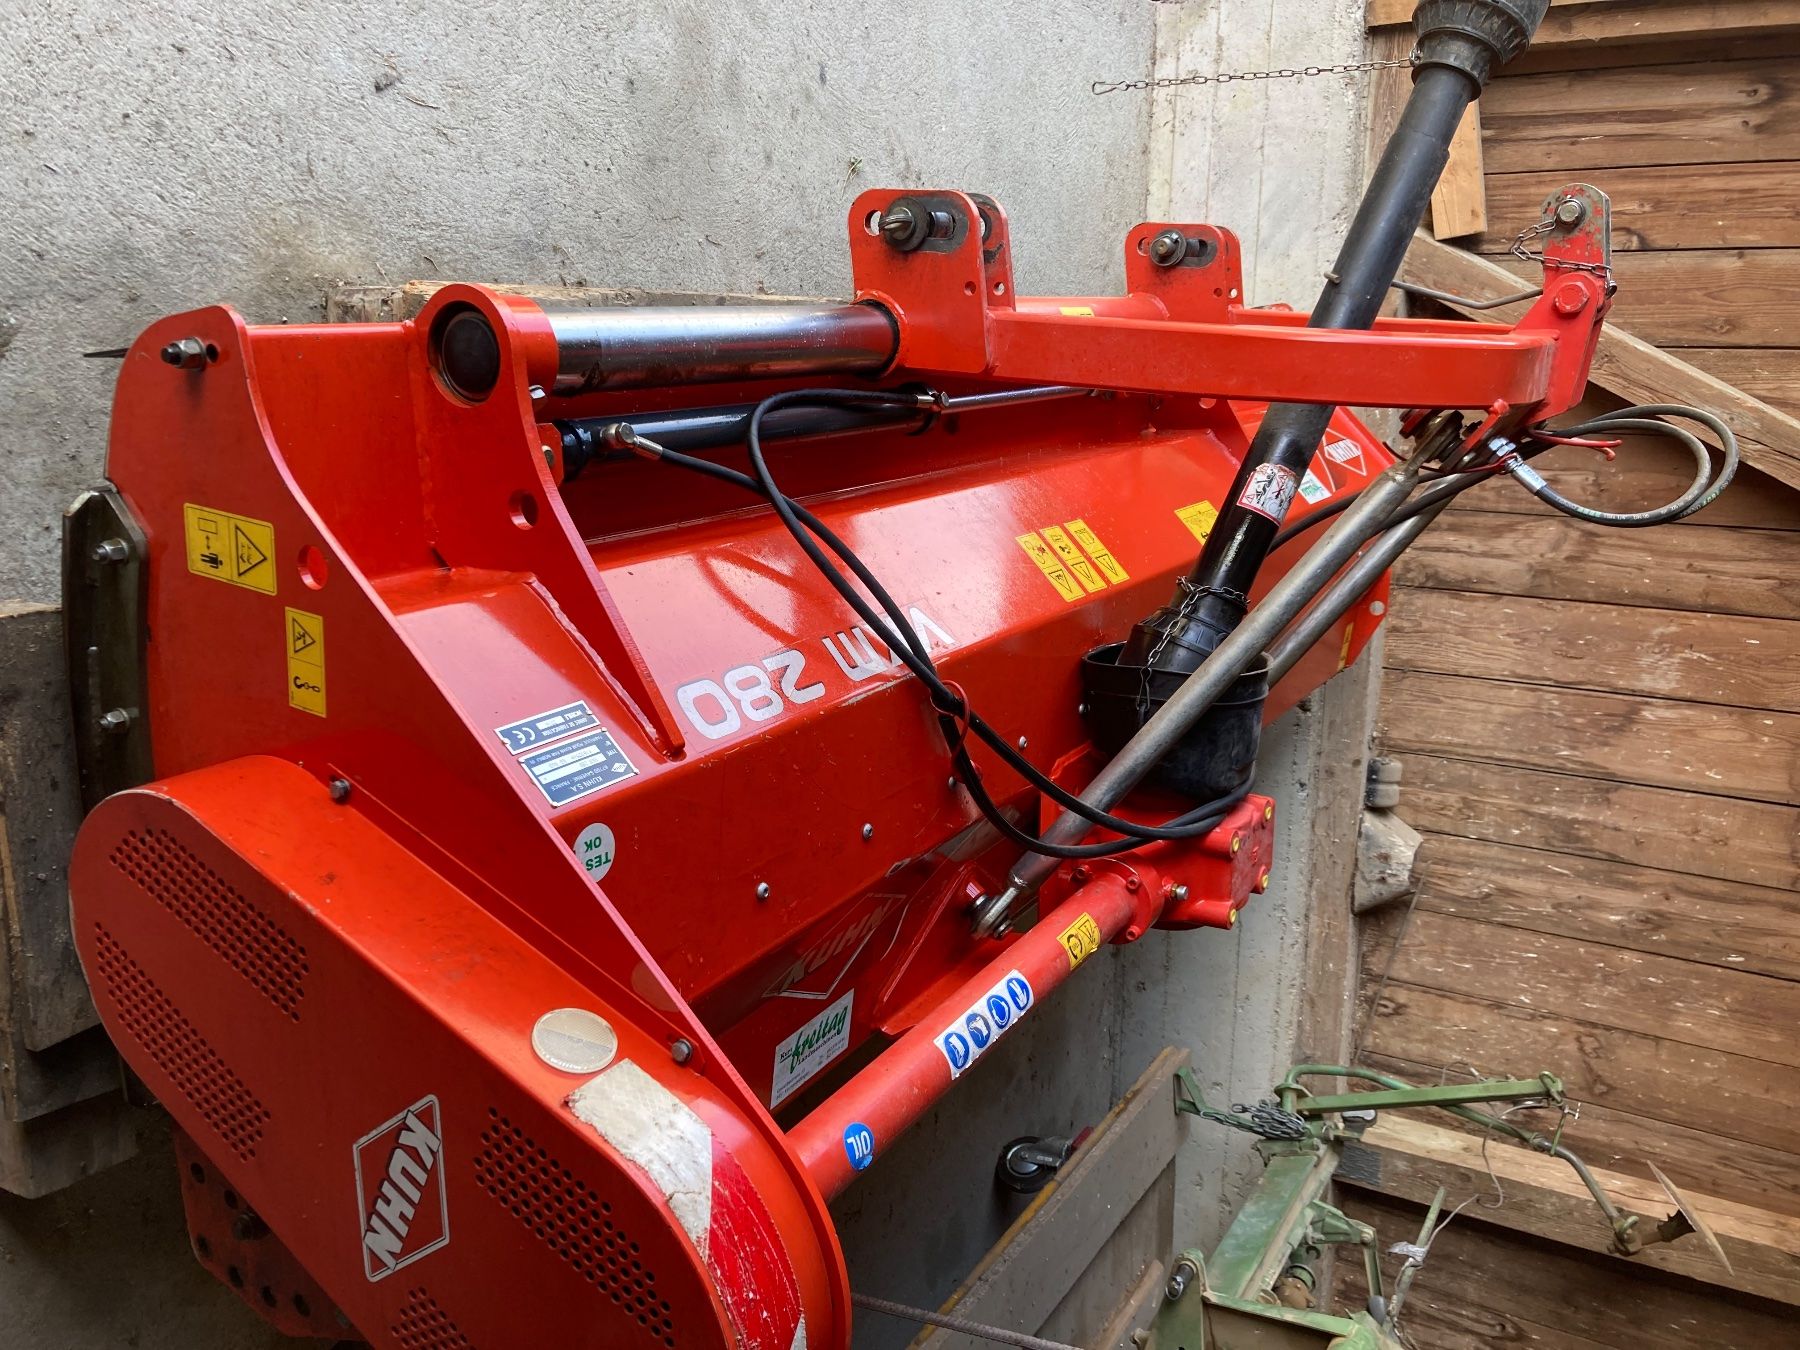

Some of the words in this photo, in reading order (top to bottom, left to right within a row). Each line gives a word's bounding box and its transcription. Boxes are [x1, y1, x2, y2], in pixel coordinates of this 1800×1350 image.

[677, 649, 826, 740] 280
[512, 727, 535, 744] CE
[550, 780, 571, 790] FRANCE
[582, 777, 603, 787] KUHN
[584, 836, 602, 854] OK
[778, 897, 892, 994] KUHN
[846, 1130, 871, 1160] OIL
[363, 1108, 441, 1271] KUHN
